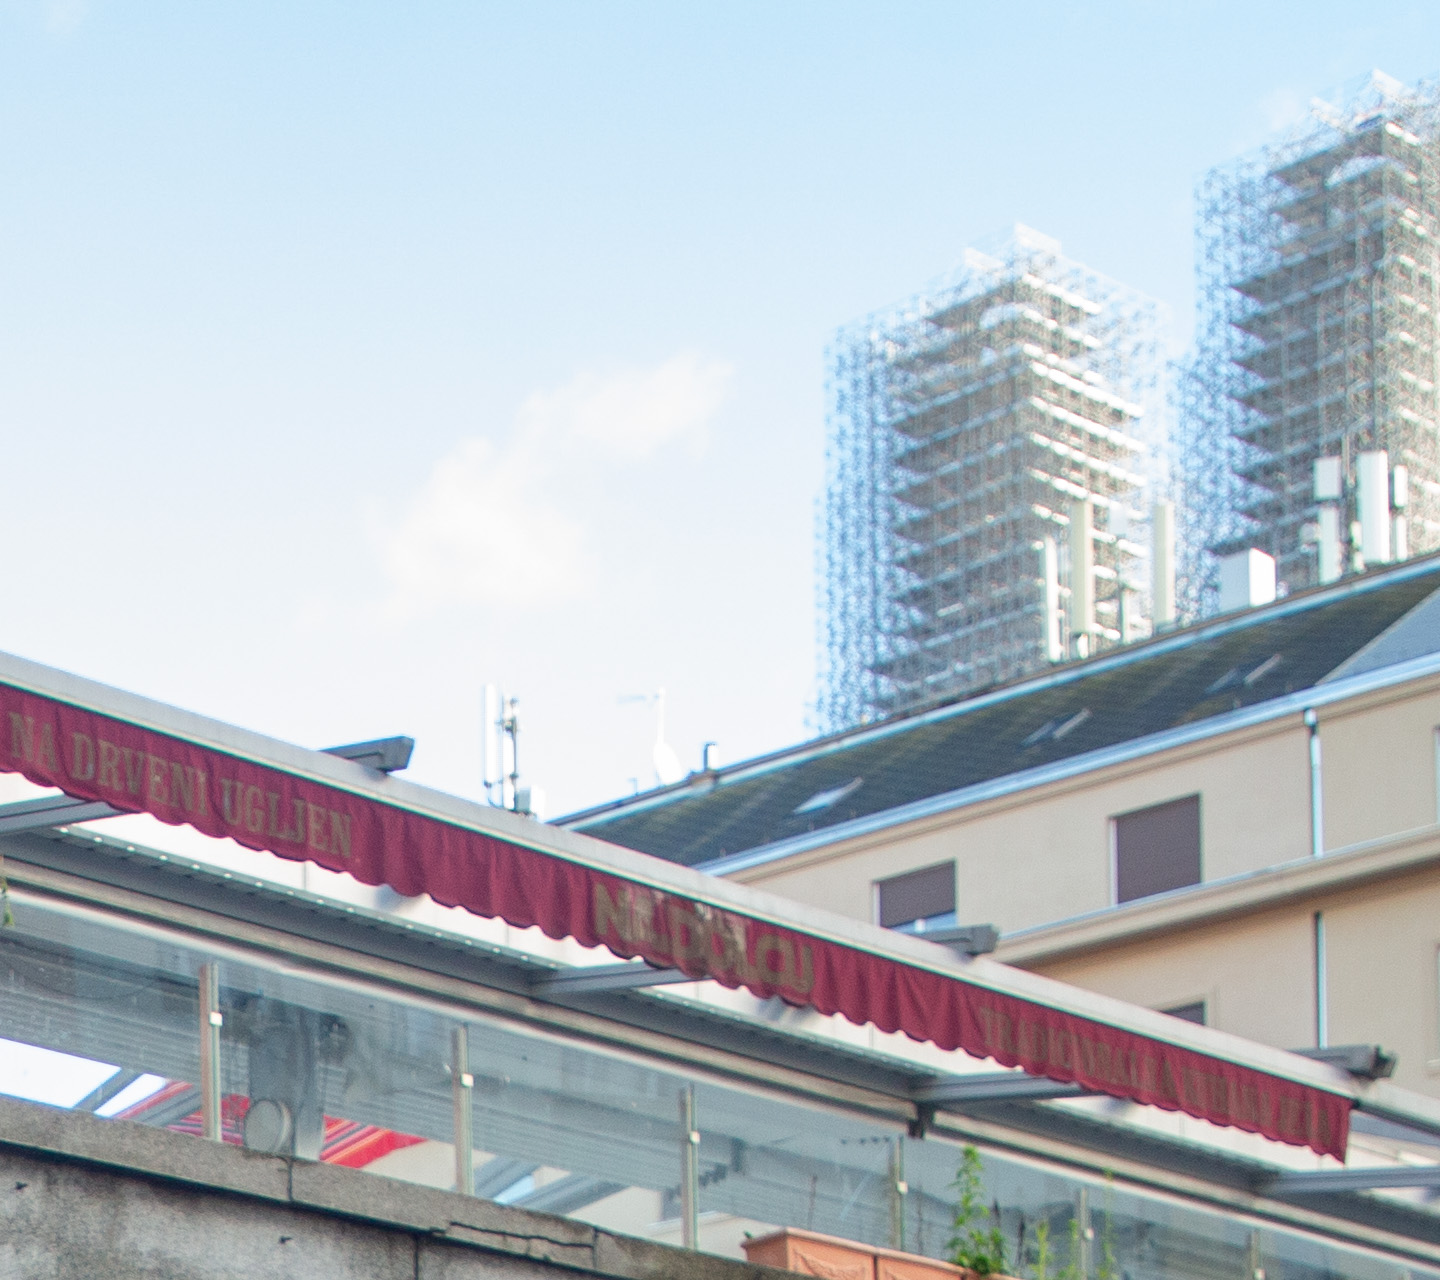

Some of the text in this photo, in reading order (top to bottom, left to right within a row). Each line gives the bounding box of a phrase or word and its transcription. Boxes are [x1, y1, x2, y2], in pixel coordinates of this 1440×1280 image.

[8, 711, 59, 774] NA
[72, 730, 208, 817] DRVENI
[221, 777, 354, 859] UGLJEN
